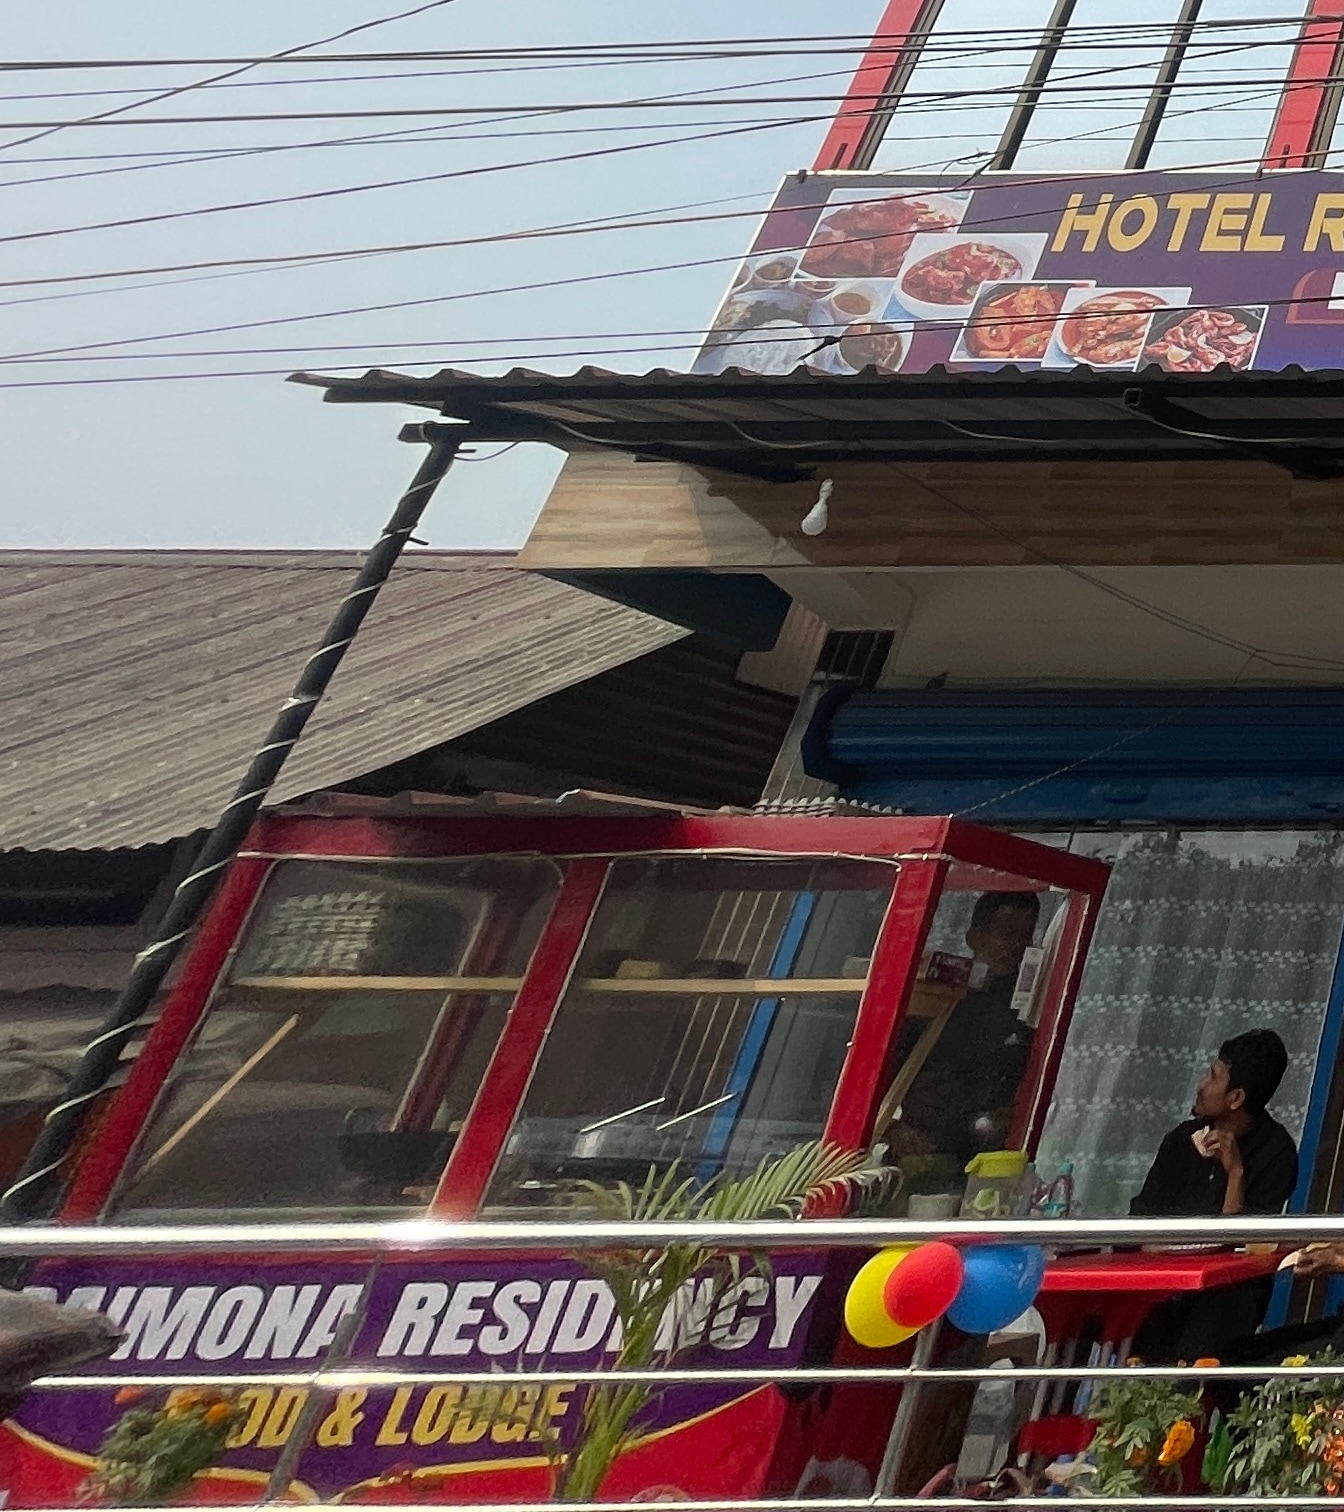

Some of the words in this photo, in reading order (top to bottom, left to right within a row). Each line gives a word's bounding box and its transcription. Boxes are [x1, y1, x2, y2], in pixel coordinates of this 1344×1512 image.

[1050, 192, 1286, 253] HOTEL
[22, 1284, 365, 1361] IMONA
[376, 1275, 824, 1358] RESIDNCY
[316, 1387, 368, 1447] &
